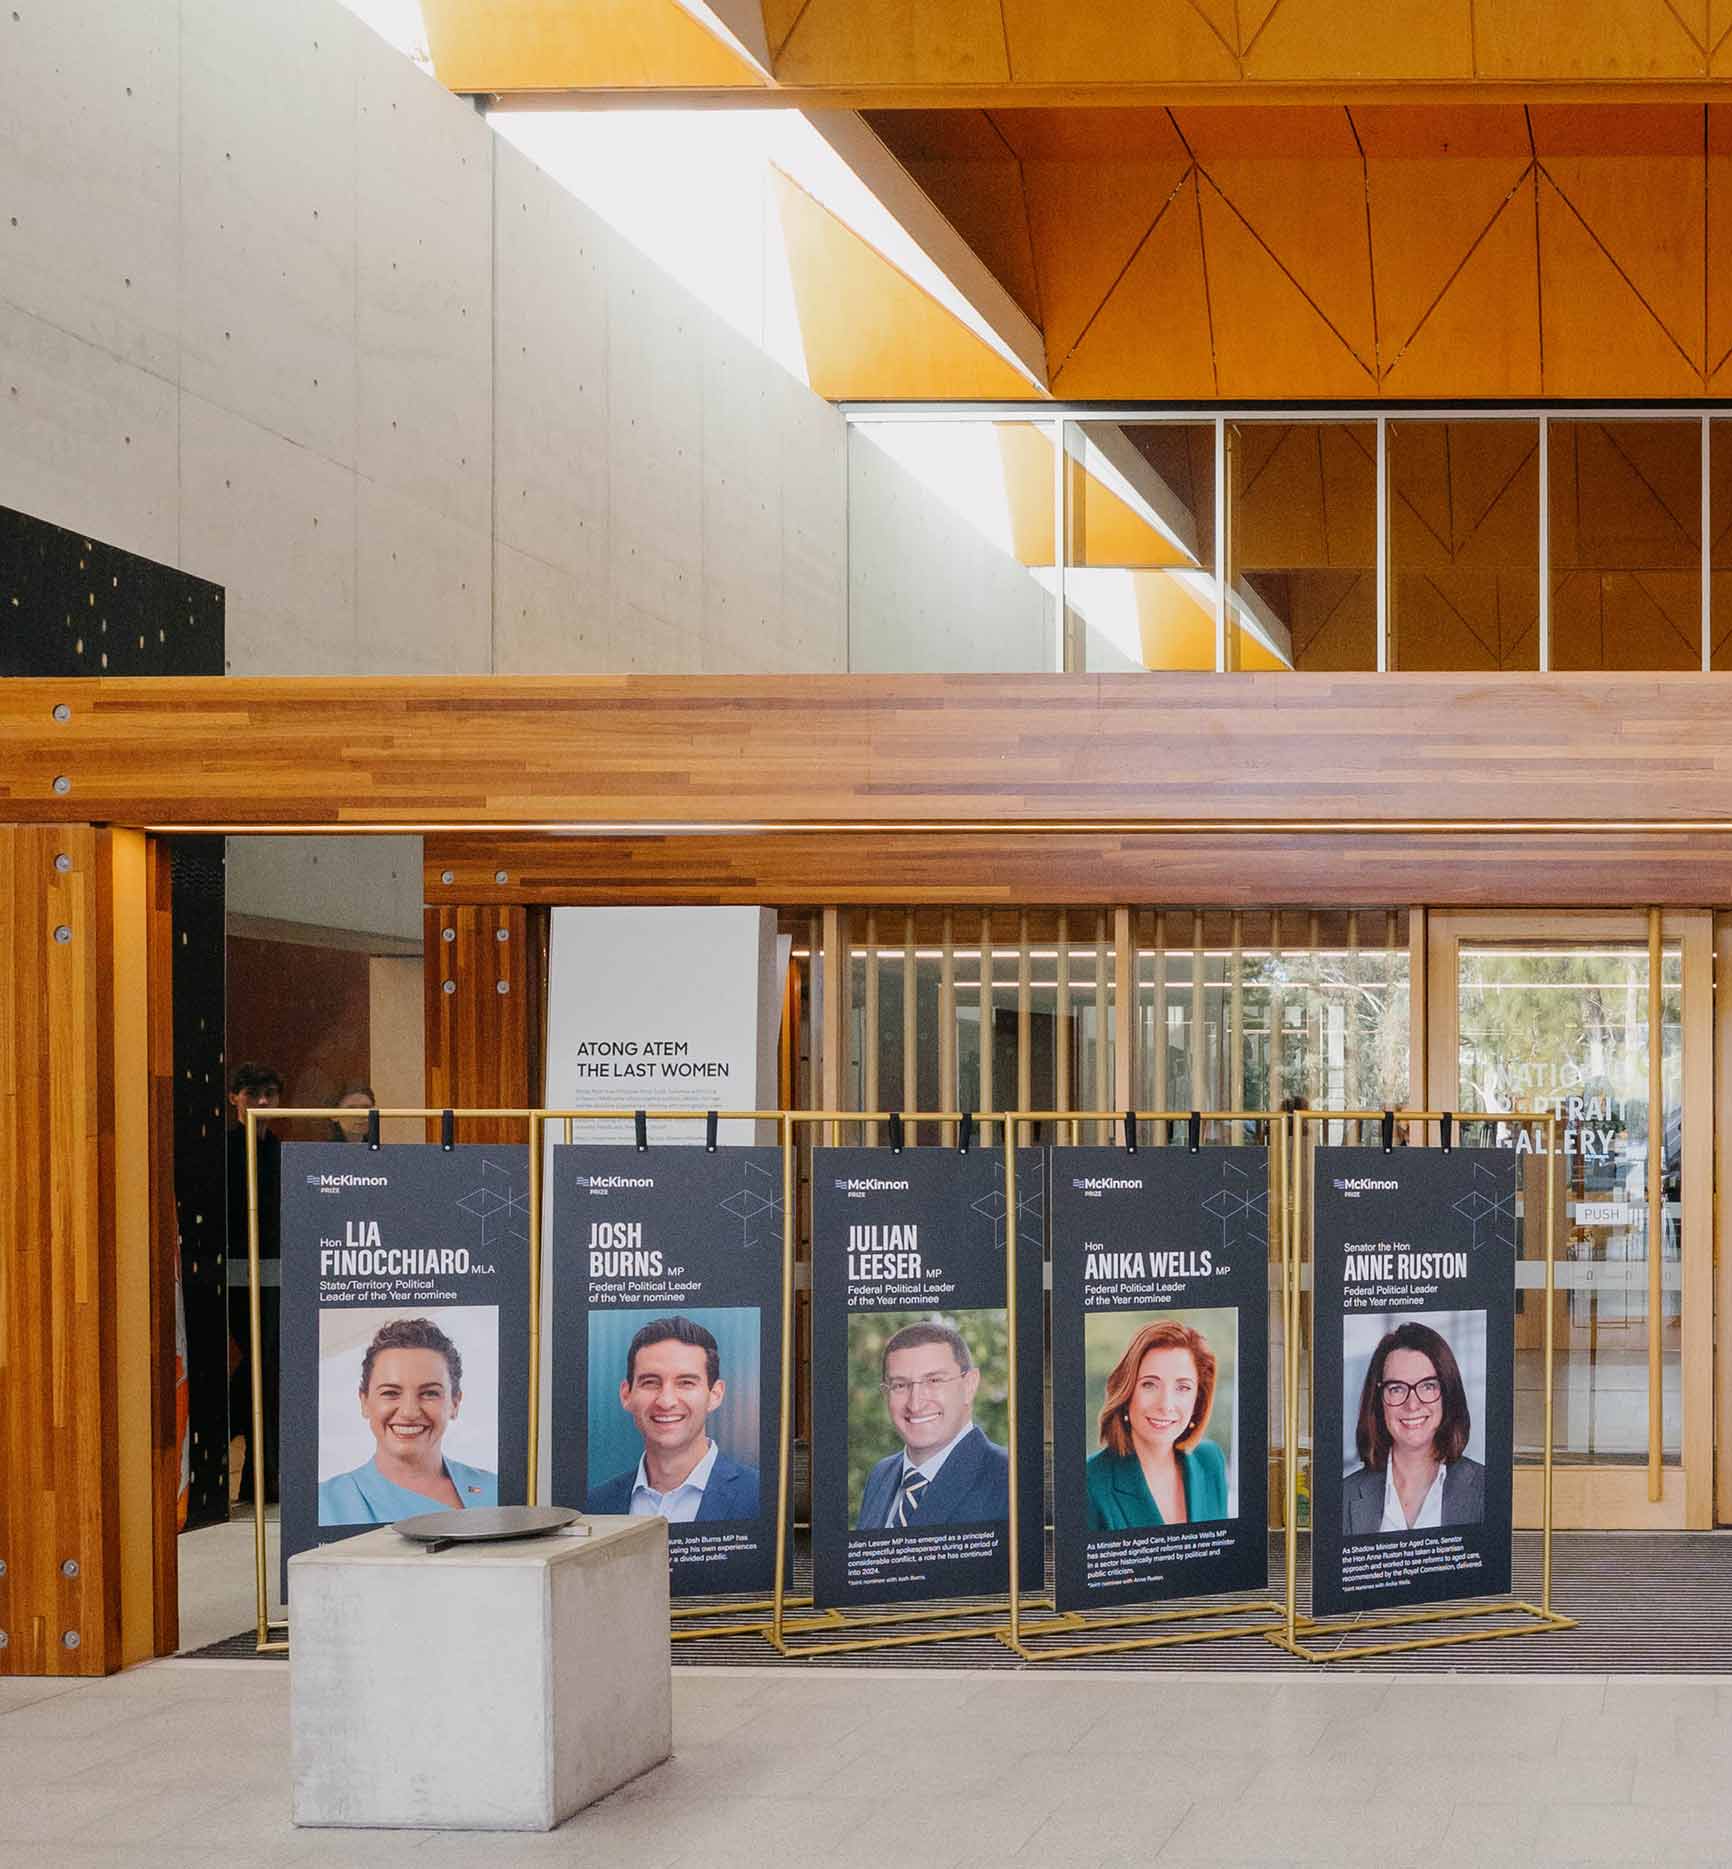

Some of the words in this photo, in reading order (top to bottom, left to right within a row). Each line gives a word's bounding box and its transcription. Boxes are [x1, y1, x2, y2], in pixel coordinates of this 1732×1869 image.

[577, 1042, 638, 1056] ATONG
[643, 1042, 688, 1056] ATEM
[577, 1063, 609, 1077] THE
[614, 1063, 656, 1077] LAST
[661, 1063, 729, 1077] WOMEN
[321, 1175, 388, 1186] McKinnon
[590, 1176, 653, 1188] McKinnon
[848, 1179, 908, 1190] McKinnon
[1085, 1178, 1142, 1189] McKinnon
[1345, 1179, 1398, 1190] McKinnon
[1585, 1209, 1619, 1219] PUSH
[320, 1238, 341, 1247] Hon
[346, 1221, 381, 1247] LIA
[589, 1223, 641, 1249] JOSH
[847, 1225, 917, 1251] JULIAN
[1085, 1242, 1103, 1251] Hon
[1344, 1243, 1376, 1252] Senator
[1378, 1242, 1391, 1251] the
[1393, 1242, 1410, 1250] Hon
[320, 1249, 469, 1276] FINOCCHIARO
[472, 1265, 495, 1274] MLA
[590, 1251, 663, 1277] BURNS
[668, 1267, 684, 1276] MP
[849, 1253, 921, 1280] LEESER
[926, 1269, 942, 1278] MP
[1085, 1253, 1146, 1279] ANIKA
[1149, 1251, 1212, 1278] WELLS
[1216, 1266, 1230, 1275] MP
[1344, 1254, 1393, 1281] ANNE
[1398, 1253, 1467, 1280] RUSTON
[320, 1280, 391, 1291] State/Territory
[395, 1279, 434, 1289] Political
[589, 1283, 625, 1292] Federal
[629, 1282, 666, 1291] Political
[669, 1282, 701, 1290] Leader
[848, 1285, 882, 1295] Federal
[886, 1284, 921, 1293] Political
[923, 1283, 955, 1292] Leader
[1085, 1285, 1118, 1294] Federal
[1121, 1283, 1154, 1292] Political
[1157, 1283, 1186, 1292] Leader
[1344, 1286, 1375, 1296] Federal
[1377, 1285, 1408, 1294] Political
[1410, 1285, 1438, 1293] Leader
[320, 1292, 351, 1302] Leader
[353, 1292, 364, 1300] of
[369, 1291, 386, 1300] the
[389, 1291, 411, 1300] Year
[414, 1291, 457, 1299] nominee
[589, 1293, 600, 1302] of
[601, 1293, 616, 1302] the
[619, 1293, 640, 1302] Year
[643, 1293, 685, 1301] nominee
[848, 1296, 857, 1305] of
[859, 1296, 873, 1305] the
[876, 1296, 896, 1305] Year
[899, 1295, 939, 1304] nominee
[1085, 1296, 1094, 1305] of
[1095, 1296, 1110, 1305] the
[1112, 1296, 1131, 1304] Year
[1133, 1295, 1171, 1303] nominee
[1344, 1298, 1353, 1307] of
[1354, 1298, 1367, 1307] the
[1369, 1297, 1387, 1306] Year
[1389, 1296, 1424, 1305] nominee
